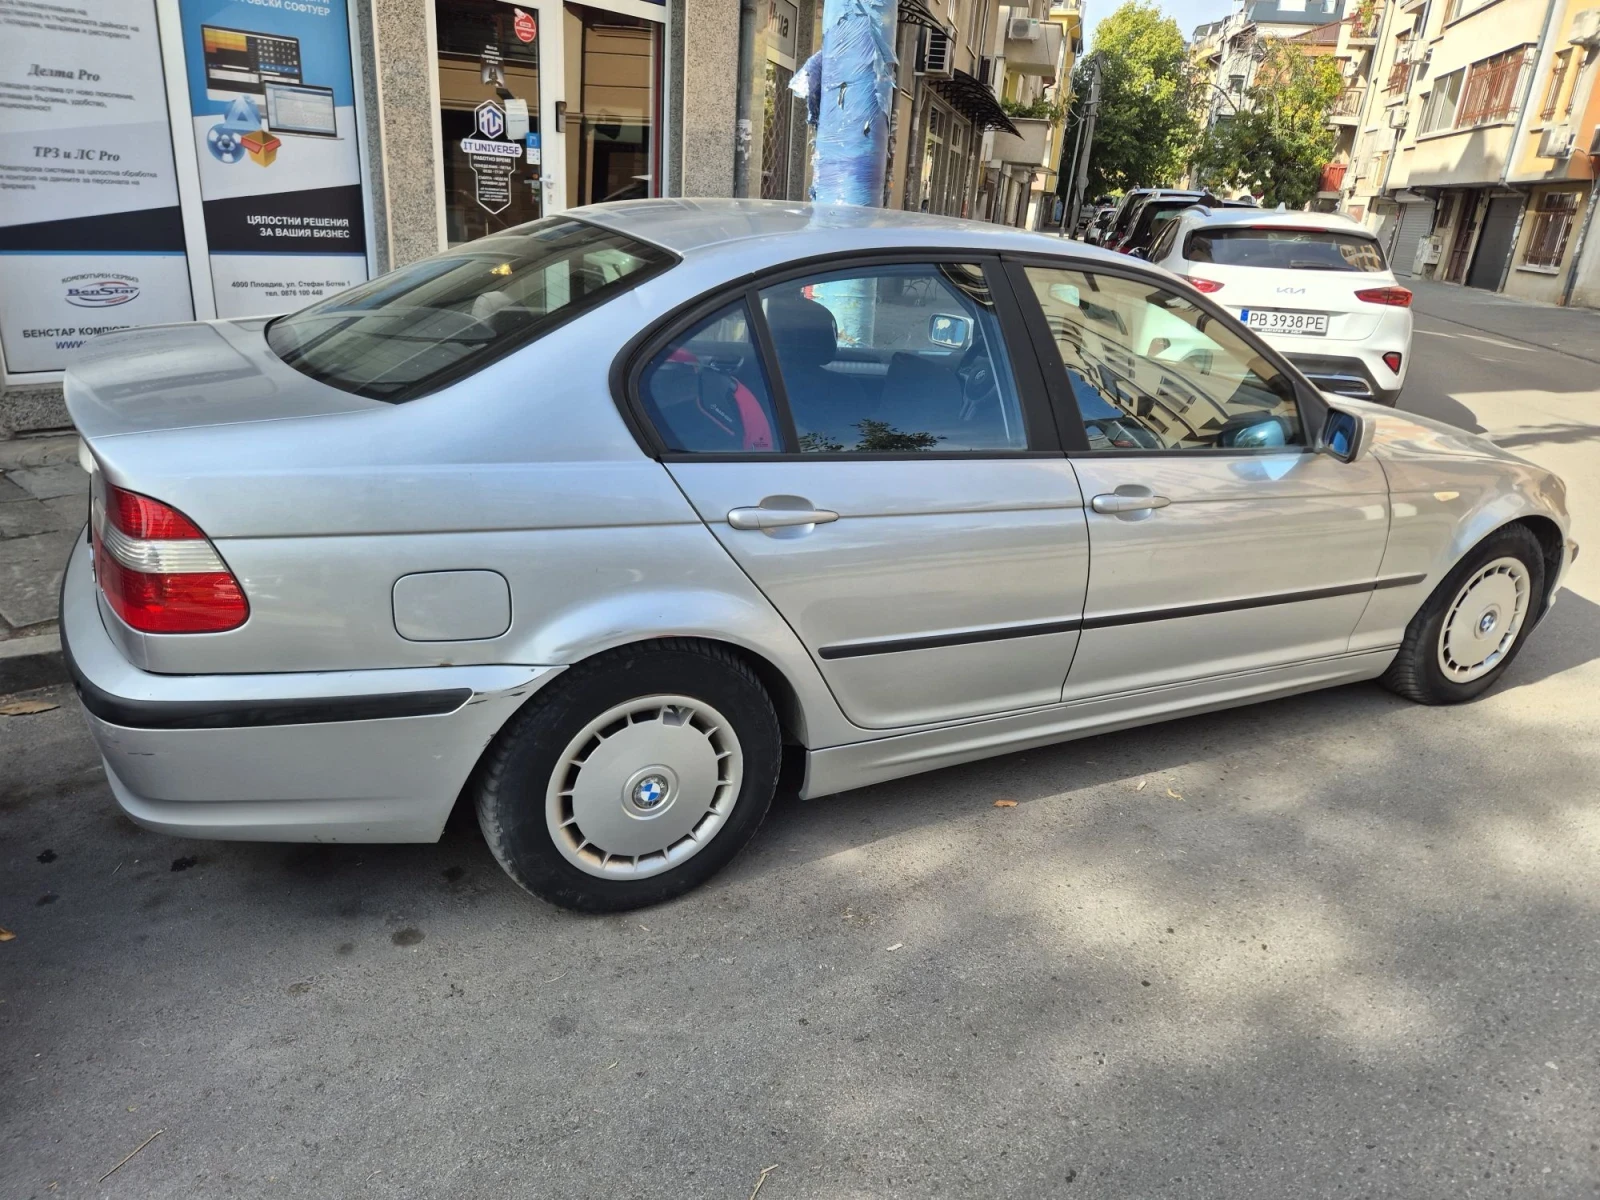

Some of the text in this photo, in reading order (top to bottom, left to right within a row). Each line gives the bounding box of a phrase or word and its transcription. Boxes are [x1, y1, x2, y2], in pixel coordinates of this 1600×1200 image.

[283, 1, 331, 16] СОФТУЕР
[27, 63, 101, 82] Делта Pro
[33, 145, 121, 162] ТРЗ и ЛС Pro
[463, 141, 520, 155] IT UNIVERSE
[246, 215, 349, 227] ЦЯЛОСТНИ РЕШЕНИЯ
[259, 227, 350, 239] ЗА ВАШИЯ БИЗНЕС
[250, 281, 285, 290] Пловдив,
[286, 282, 296, 290] ул.
[298, 280, 325, 288] Стефан
[1276, 287, 1306, 295] KIA
[65, 286, 139, 297] BenStar
[265, 289, 279, 298] тел.
[1249, 313, 1325, 330] PB 3938 PE
[22, 327, 76, 339] БЕНСТАР
